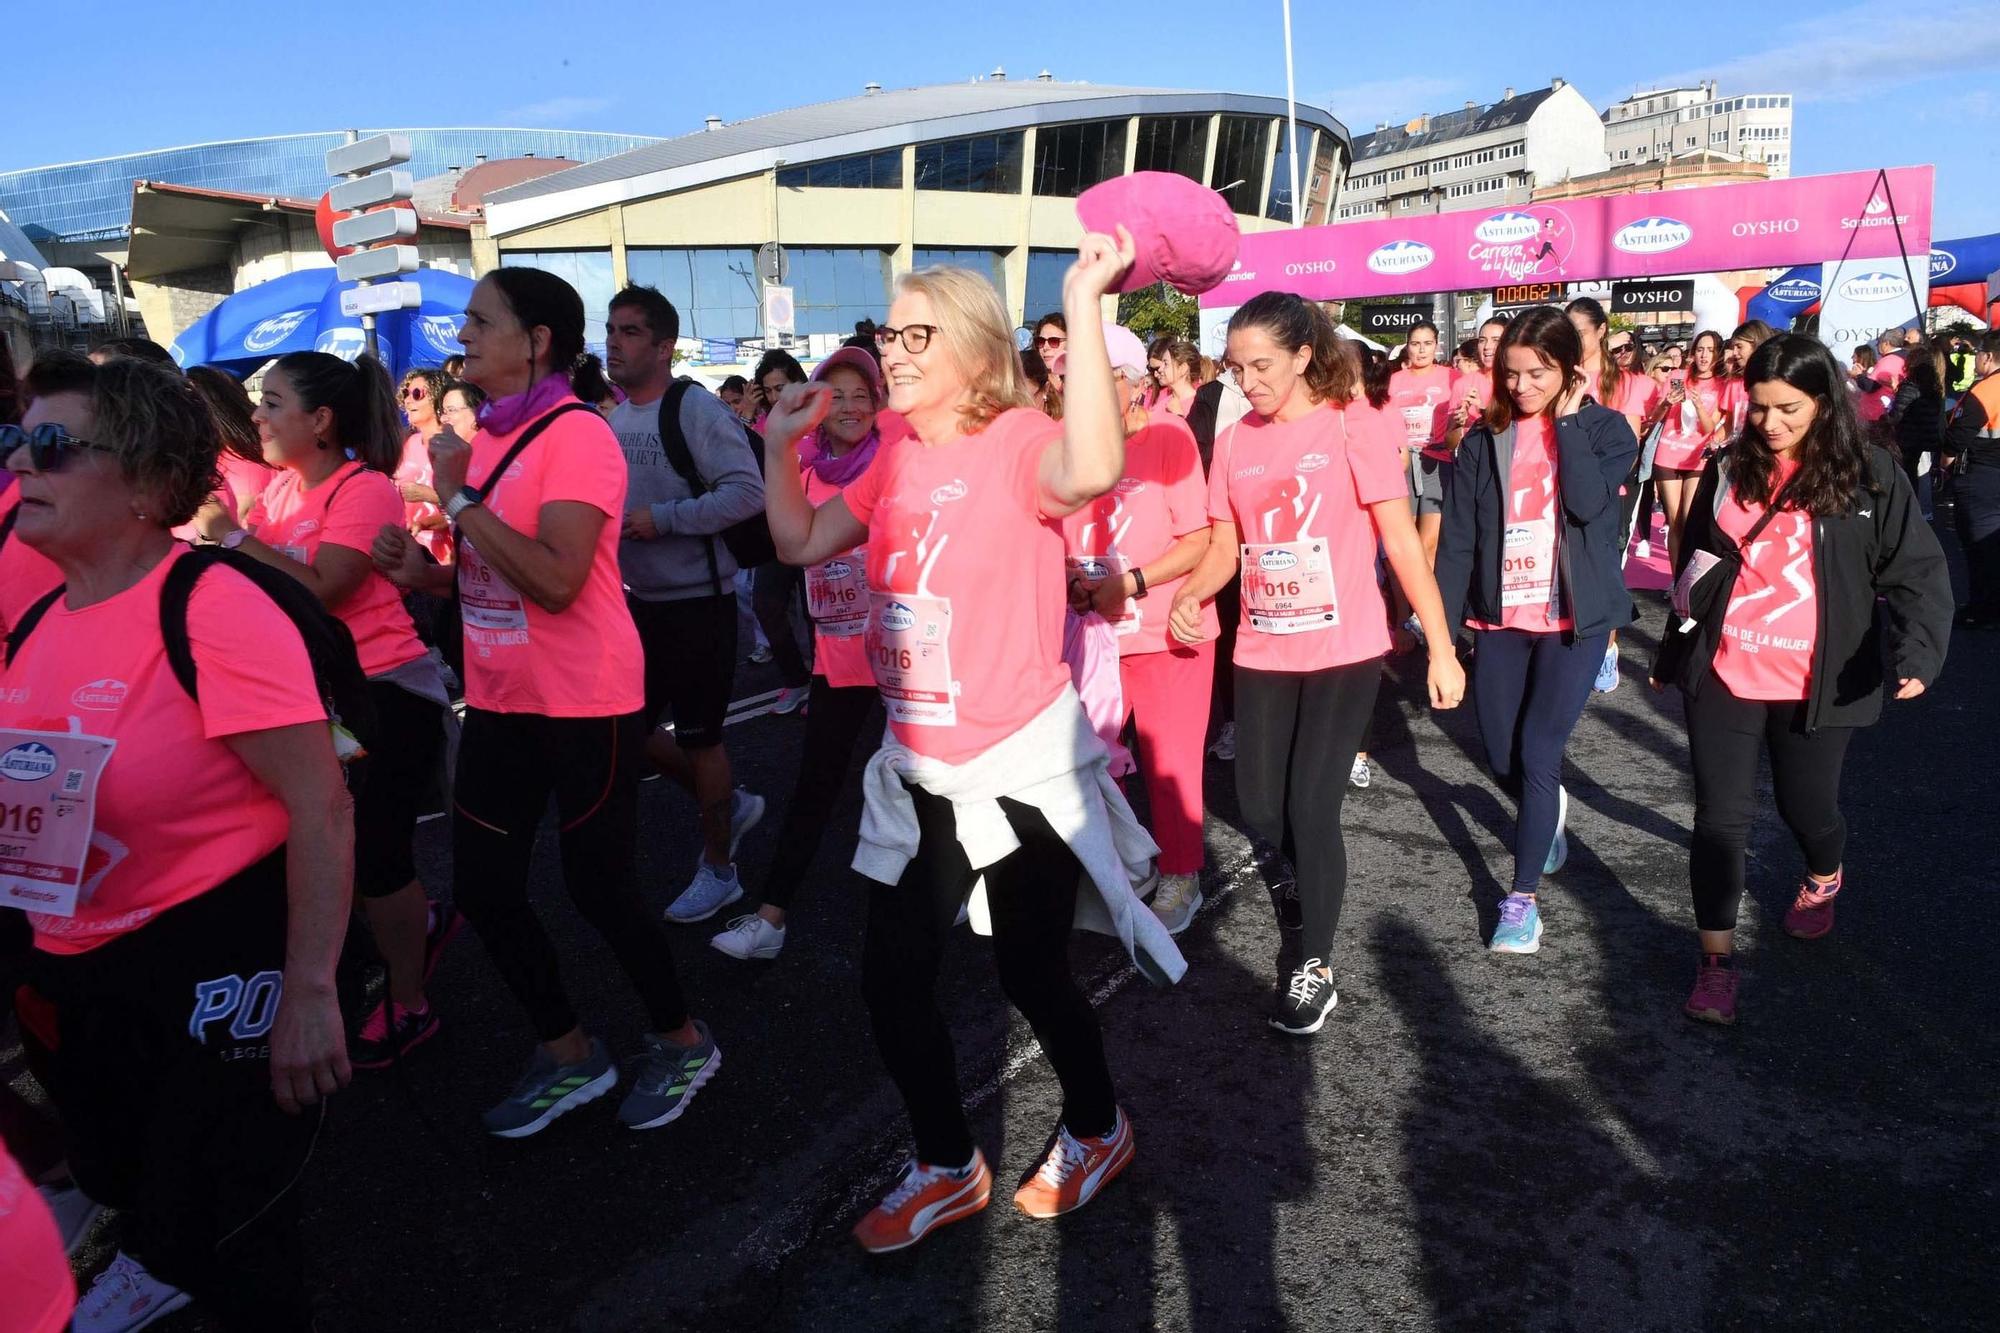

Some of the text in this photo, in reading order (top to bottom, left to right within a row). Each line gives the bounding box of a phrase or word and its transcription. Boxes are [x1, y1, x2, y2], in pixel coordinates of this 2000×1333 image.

[1732, 218, 1800, 237] OYSHO
[1841, 215, 1909, 229] Santander
[1481, 224, 1536, 238] ASTURIANA
[1619, 230, 1686, 246] ASTURIANA
[1468, 243, 1524, 261] Carrera
[1285, 260, 1336, 276] OYSHO
[1373, 254, 1429, 268] ASTURIANA
[1481, 260, 1492, 272] de
[1500, 254, 1544, 281] Mujer
[1623, 290, 1683, 304] OYSHO
[1771, 287, 1818, 297] ASTURIANA
[1844, 284, 1904, 296] ASTURIANA
[1371, 313, 1423, 327] OYSHO
[1504, 556, 1536, 572] 016
[1264, 581, 1300, 597] 016
[1740, 628, 1755, 642] DE
[1756, 633, 1770, 646] LA
[1772, 635, 1809, 652] MUJER
[880, 646, 912, 670] 016
